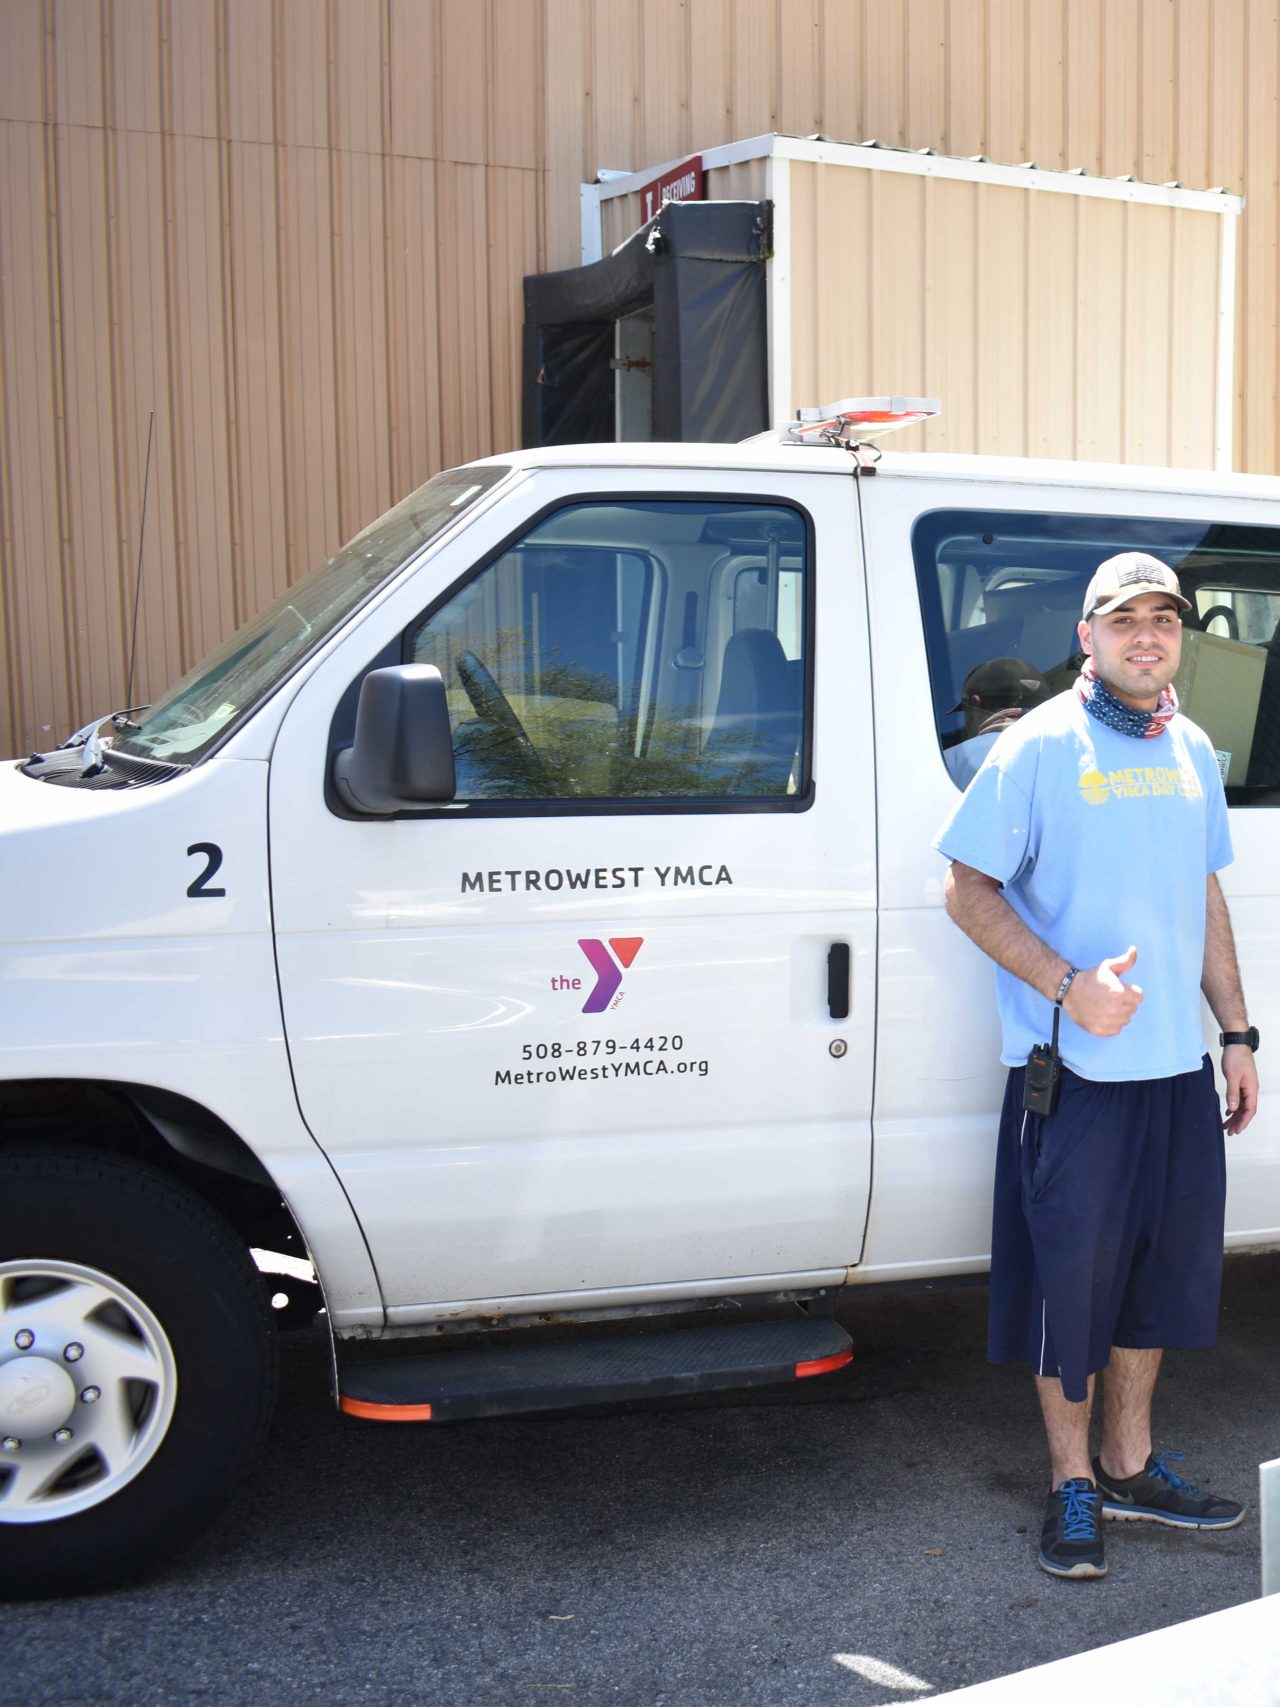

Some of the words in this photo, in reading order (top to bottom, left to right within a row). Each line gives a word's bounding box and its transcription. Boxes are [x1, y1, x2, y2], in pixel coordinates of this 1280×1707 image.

[662, 171, 696, 202] RECEIVING
[186, 842, 226, 898] 2
[460, 867, 645, 893] METROWEST
[654, 864, 734, 887] YMCA
[551, 974, 582, 991] the
[610, 991, 626, 1011] YMCA
[522, 1035, 684, 1060] 508-879-4420
[494, 1060, 710, 1086] MetroWestYMCA.org
